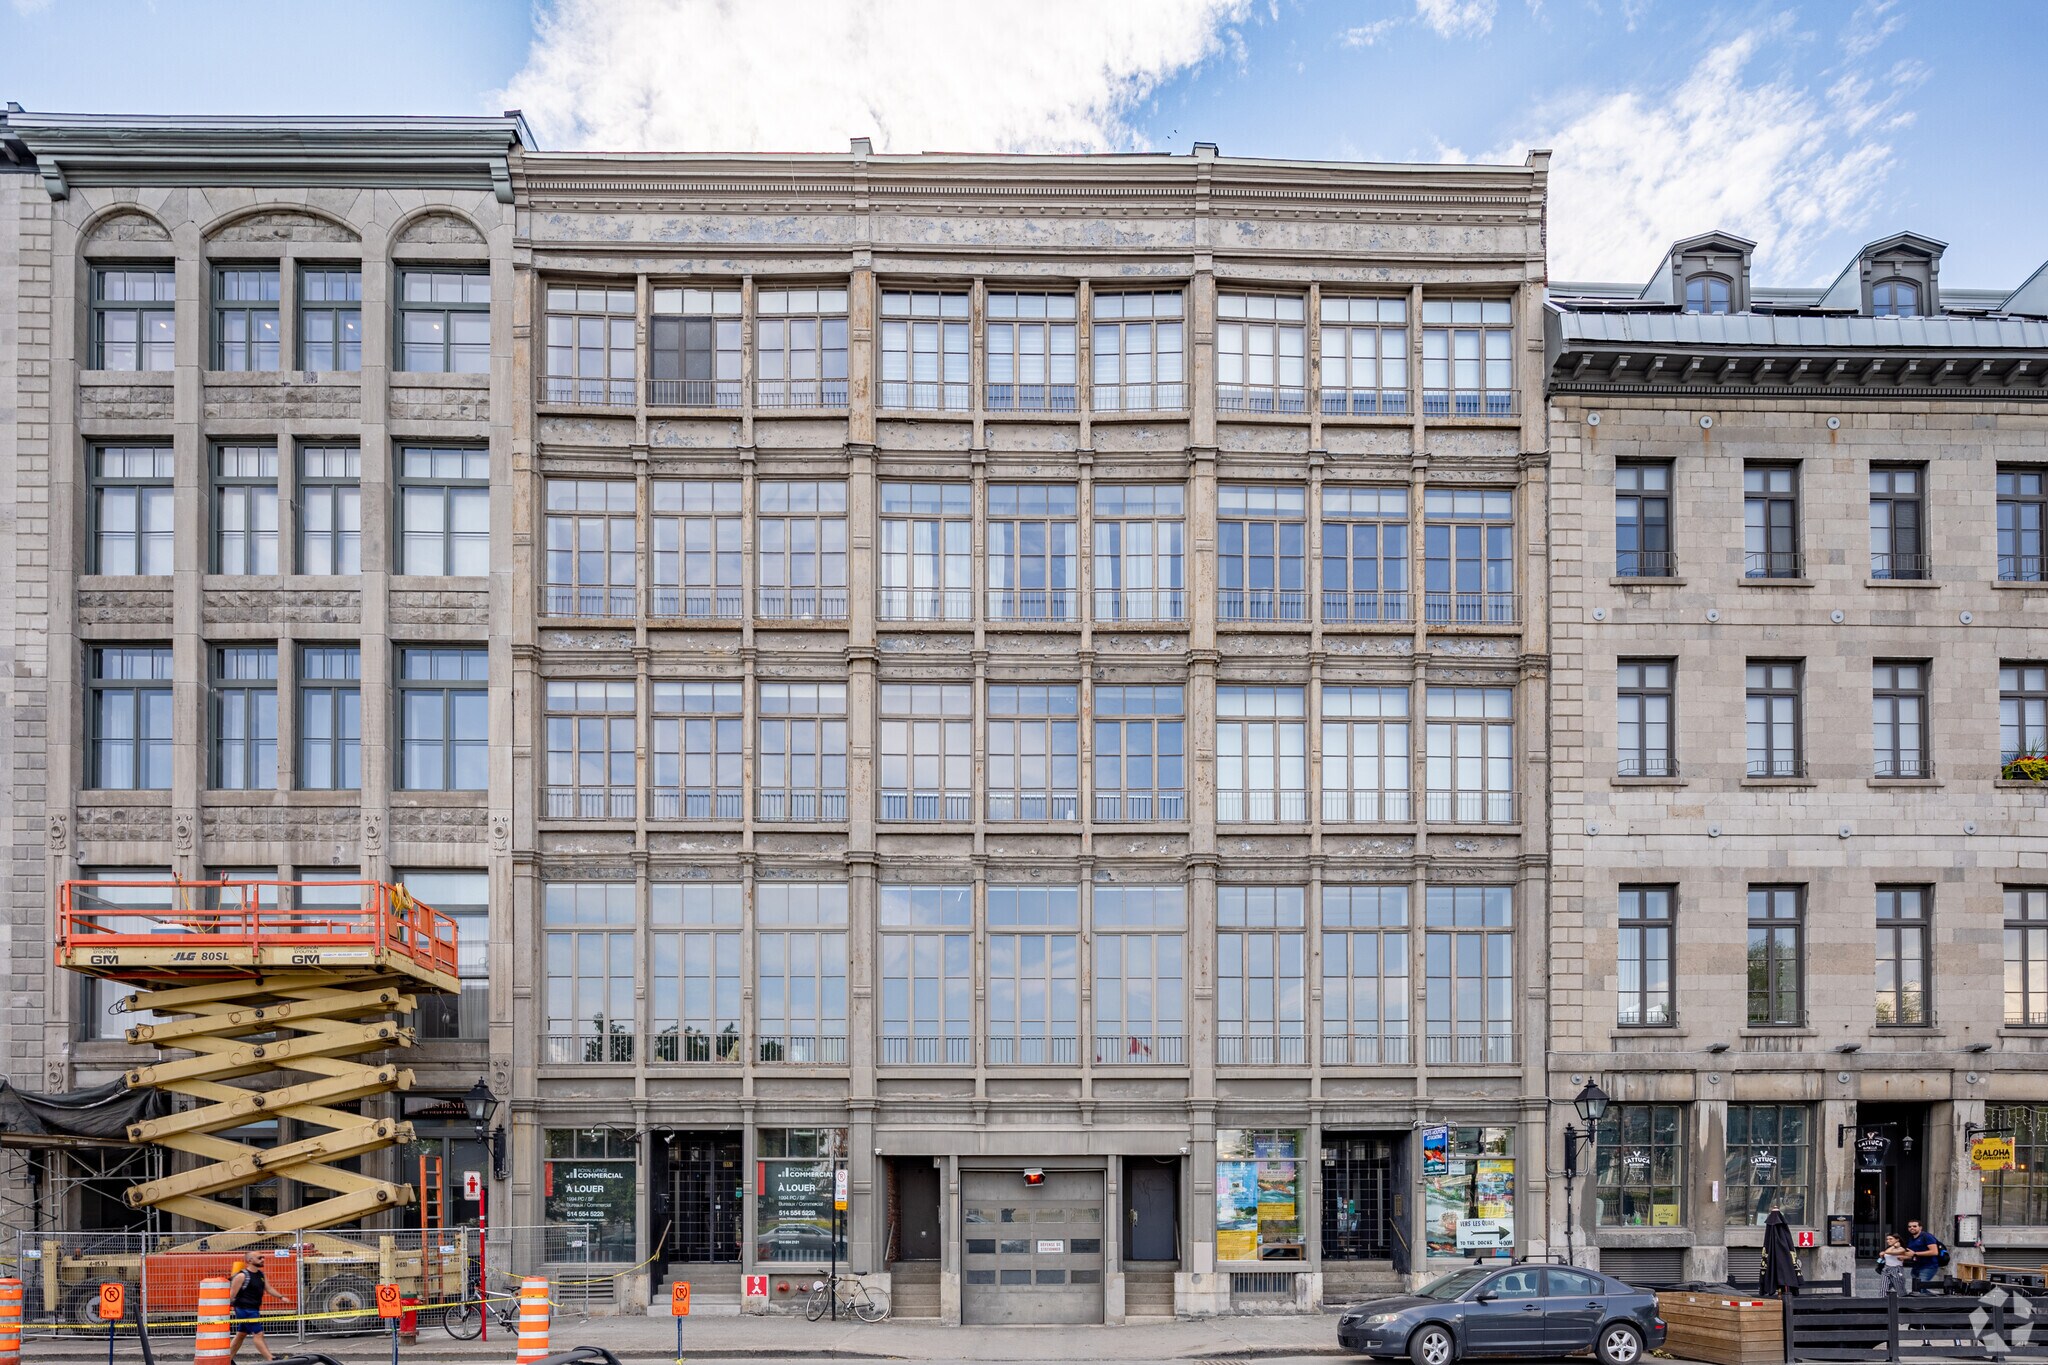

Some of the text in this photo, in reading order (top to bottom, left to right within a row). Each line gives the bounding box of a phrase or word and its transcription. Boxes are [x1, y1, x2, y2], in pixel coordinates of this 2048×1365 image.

[91, 955, 119, 965] GM
[173, 952, 229, 961] JLG 80SL
[292, 955, 320, 964] GM
[1858, 1139, 1883, 1148] LATTUCA
[1623, 1157, 1650, 1165] LATTUCA
[1750, 1157, 1777, 1165] LATTUCA
[566, 1183, 604, 1193] À LOUER
[778, 1182, 816, 1192] À LOUER
